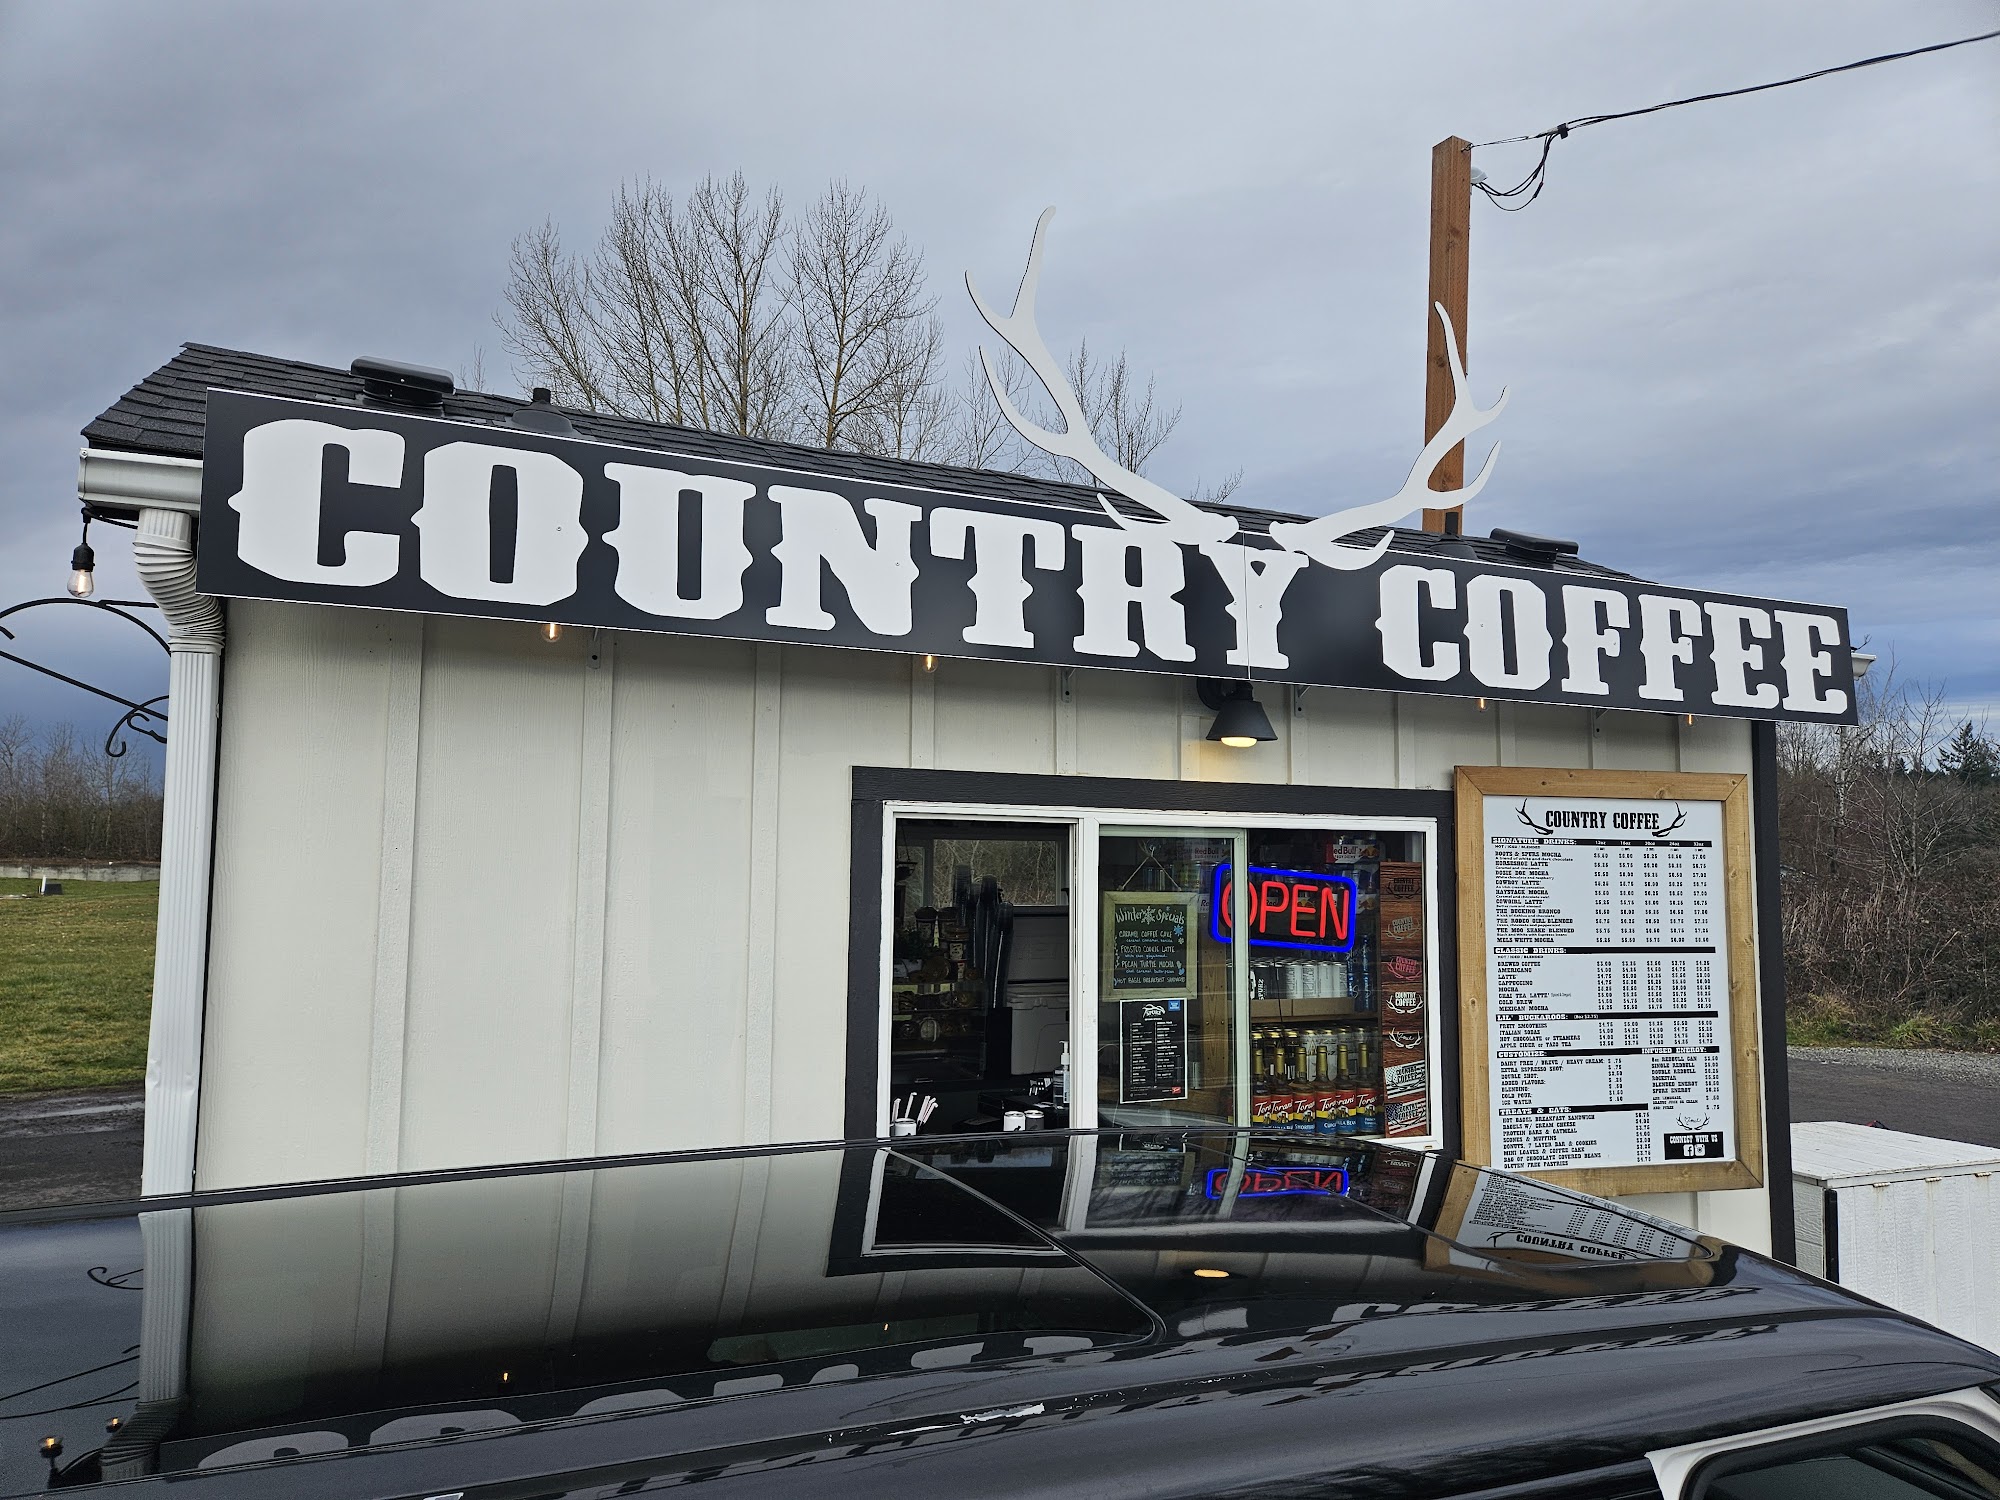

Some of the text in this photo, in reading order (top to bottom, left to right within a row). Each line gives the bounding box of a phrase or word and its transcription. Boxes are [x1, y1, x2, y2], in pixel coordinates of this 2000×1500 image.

[227, 418, 1848, 715] COUNTRY COFFEE
[1545, 811, 1660, 830] COUNTRY COFFEE
[1333, 846, 1342, 854] ed
[1116, 907, 1185, 924] Winter Specials
[1221, 881, 1350, 941] OPEN
[1392, 916, 1413, 927] COUNTRY
[1393, 924, 1414, 933] COFFEE
[1141, 930, 1158, 938] COFFEE
[1121, 945, 1141, 953] FROSTED
[1140, 960, 1156, 968] TURTLE
[1396, 956, 1417, 965] COUNTRY
[1395, 962, 1416, 973] COFFEE
[1395, 999, 1416, 1007] COFFEE
[1396, 1066, 1417, 1076] COUNTRY
[1397, 1073, 1418, 1084] COFFEE
[1271, 1100, 1293, 1114] Torani
[1295, 1099, 1315, 1113] Toran
[1398, 1103, 1418, 1113] COUNTRY
[1398, 1110, 1419, 1121] COFFEE
[1695, 1135, 1709, 1143] WITH
